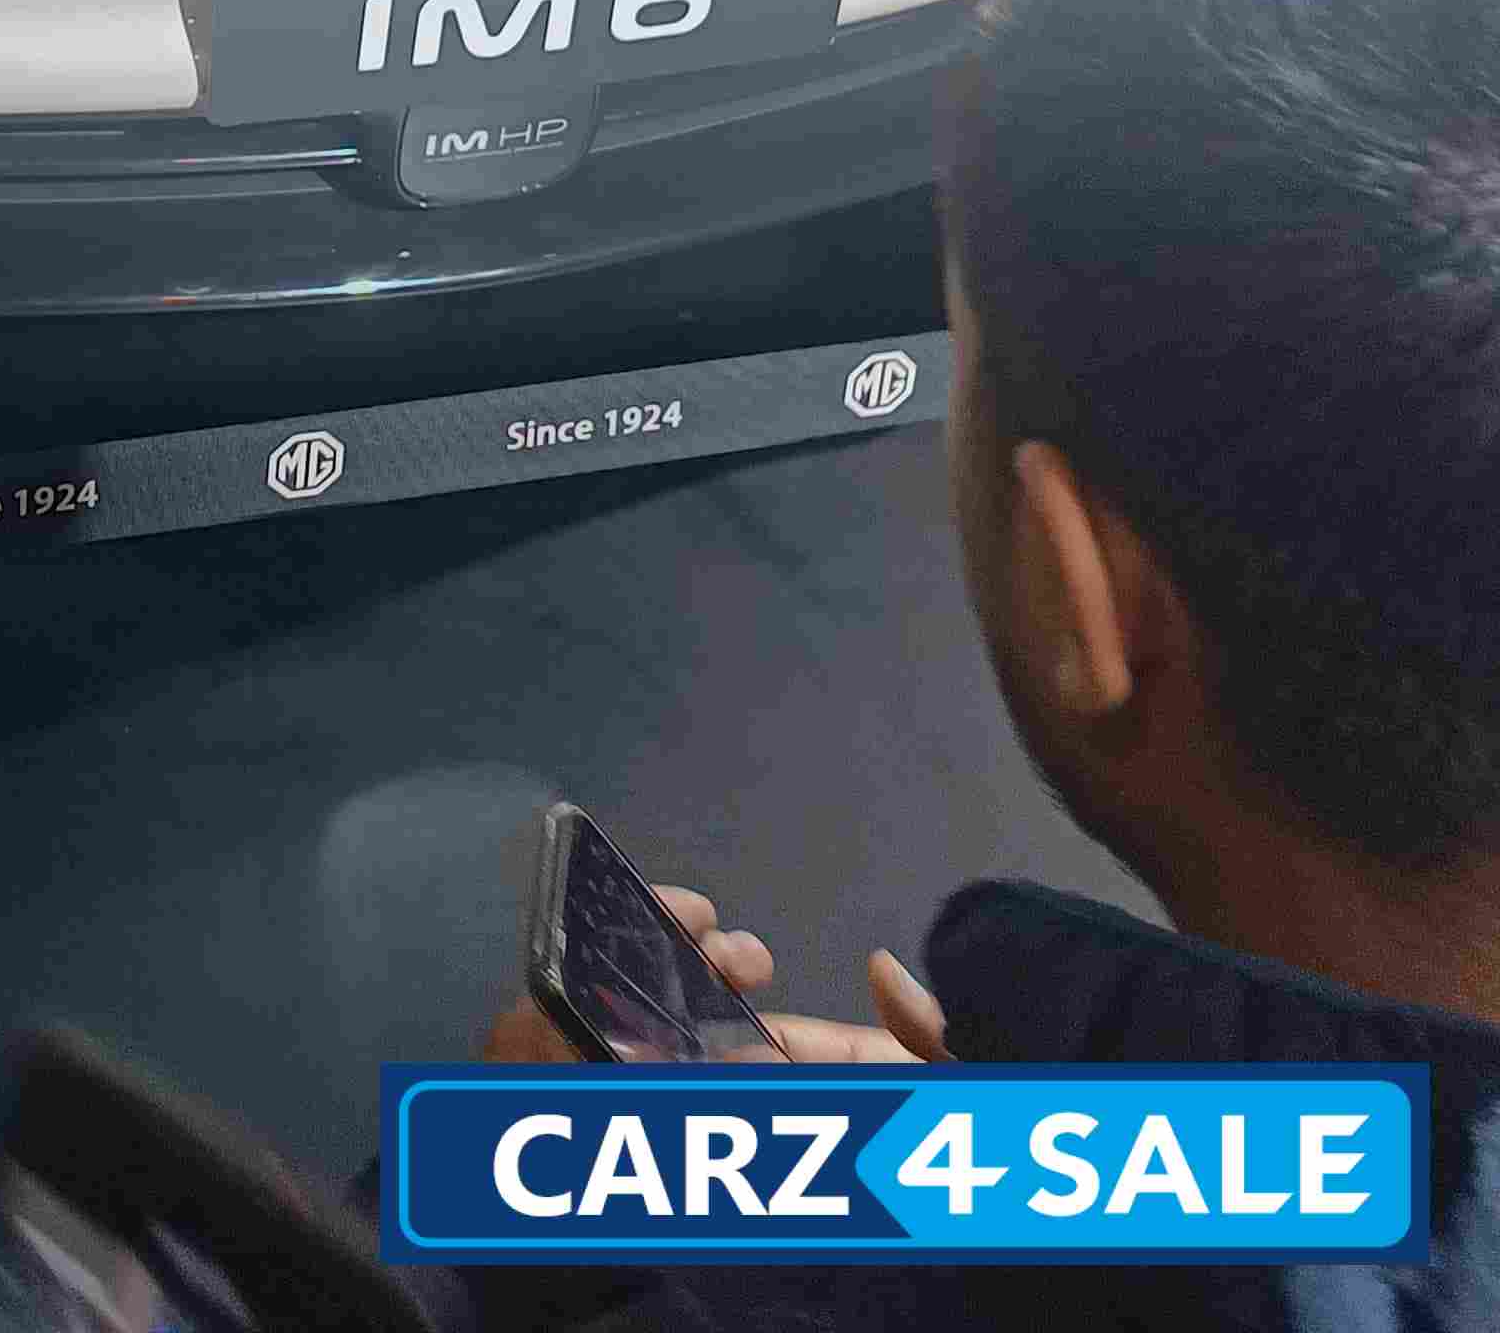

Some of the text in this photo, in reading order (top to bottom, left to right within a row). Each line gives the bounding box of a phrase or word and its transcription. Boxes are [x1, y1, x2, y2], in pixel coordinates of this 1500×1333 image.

[425, 117, 569, 157] IM HP
[853, 359, 909, 409] MG
[506, 400, 683, 452] Since 1924
[275, 438, 337, 491] MG
[14, 479, 99, 517] 1924
